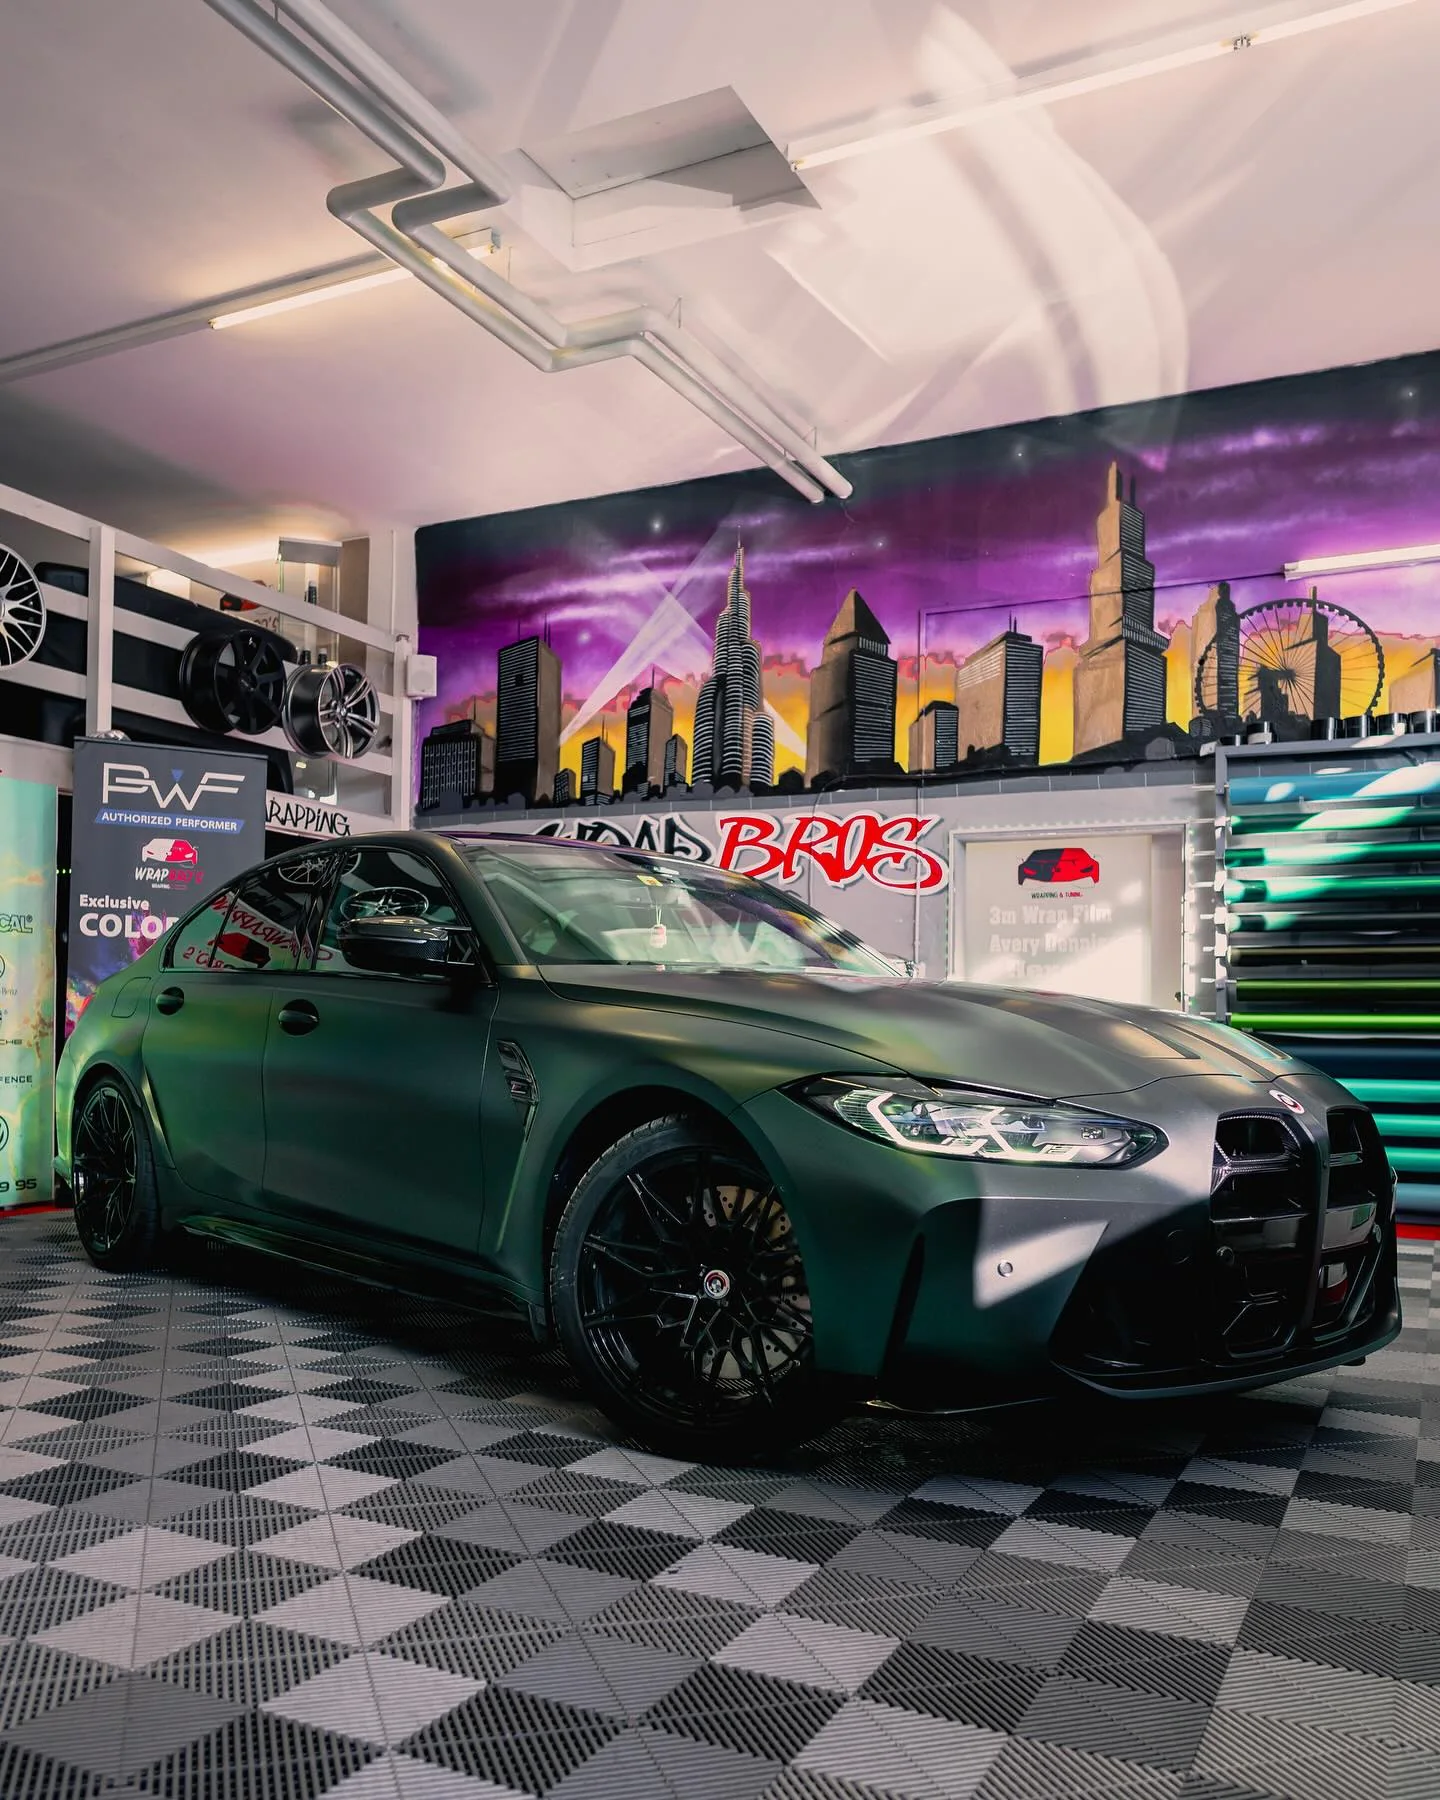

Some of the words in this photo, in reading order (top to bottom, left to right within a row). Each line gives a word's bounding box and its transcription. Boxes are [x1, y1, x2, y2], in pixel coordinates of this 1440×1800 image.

[102, 762, 246, 811] PWF
[102, 811, 172, 826] AUTHORIZED
[175, 817, 237, 831] PERFORMER
[719, 815, 943, 889] BROS
[79, 894, 150, 911] Exclusive
[989, 932, 1040, 956] Avery
[15, 1178, 38, 1191] 95
